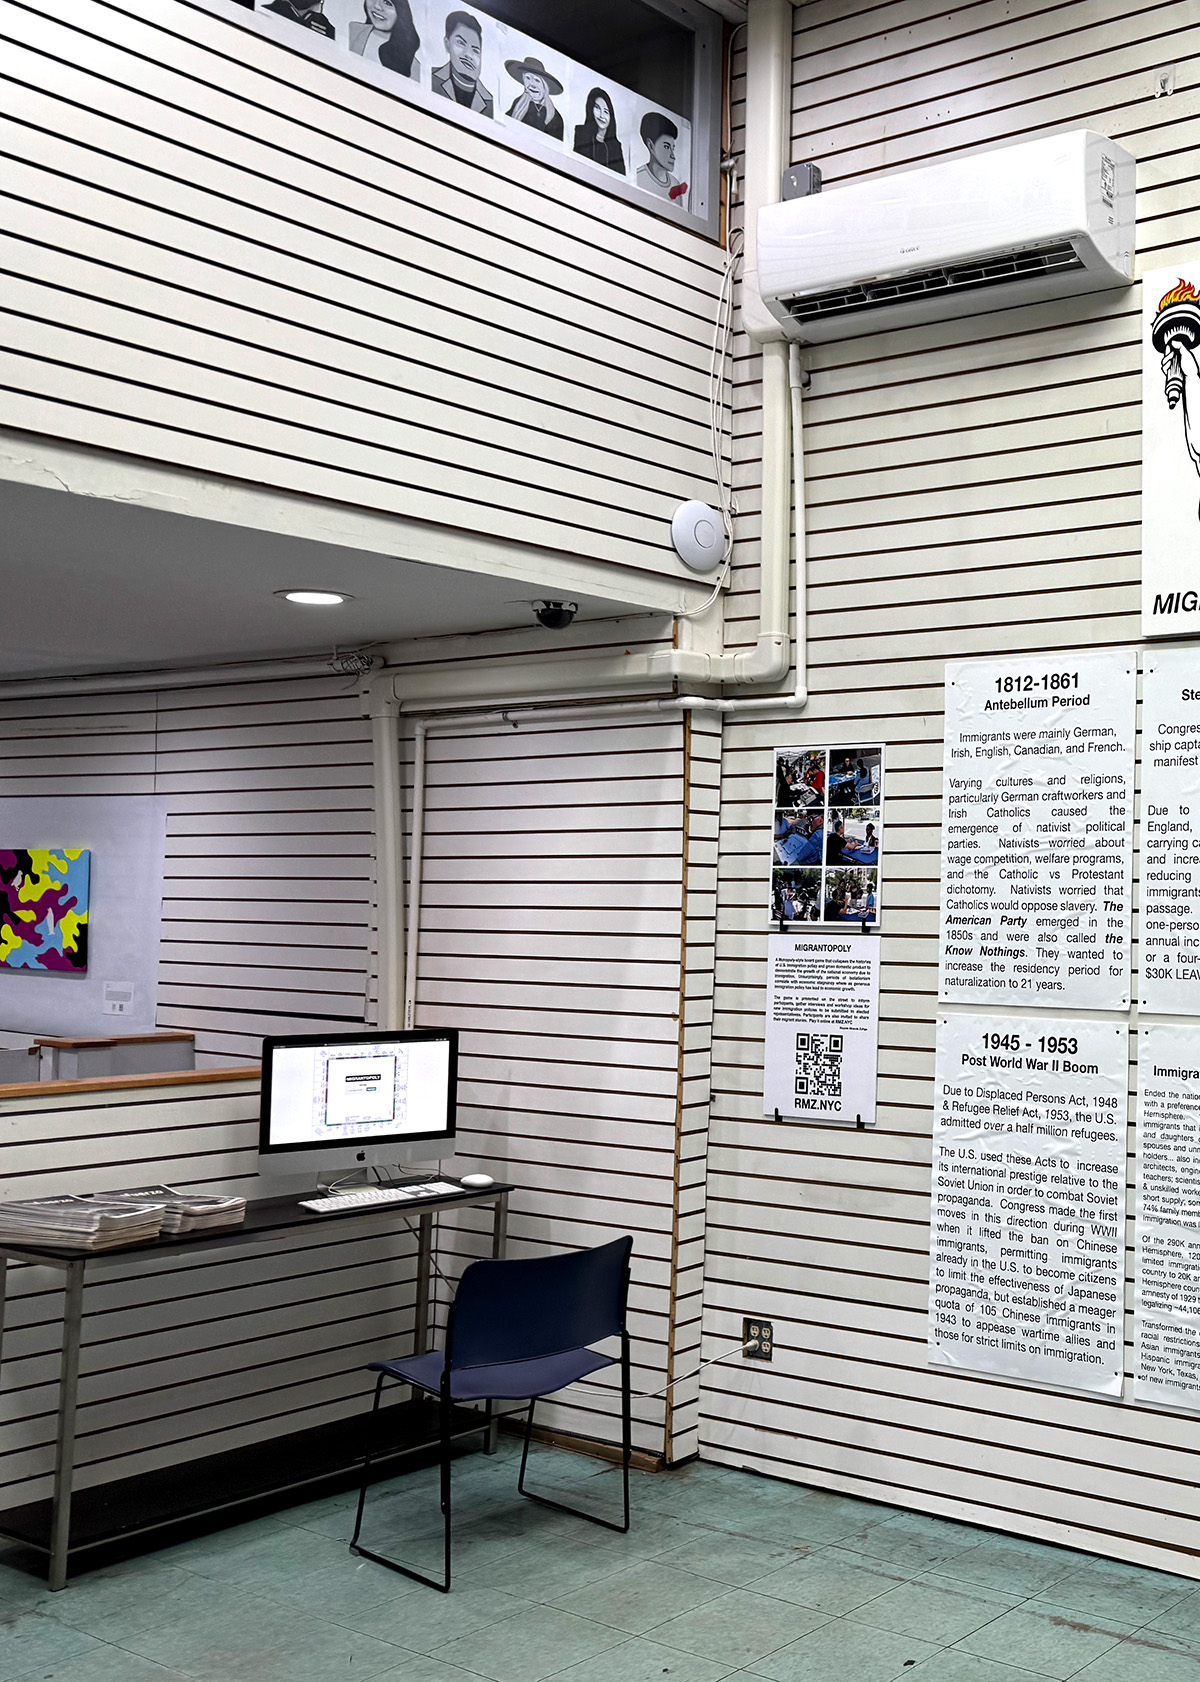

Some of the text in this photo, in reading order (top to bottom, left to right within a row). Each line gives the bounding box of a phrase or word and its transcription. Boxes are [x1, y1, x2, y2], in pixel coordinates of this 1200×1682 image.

[995, 672, 1078, 693] 1812-1861
[984, 694, 1090, 711] Antebellum Period
[951, 741, 1125, 759] Irish, English, Canadian, and French.
[794, 943, 852, 953] MIGRANTOPOLY
[1145, 967, 1173, 979] $30K
[982, 1033, 1020, 1051] 1945
[1038, 1036, 1078, 1055] 1953
[961, 1053, 1098, 1074] Post World War II Boom
[794, 1097, 842, 1112] RMZ.NYC
[1141, 1299, 1173, 1312] legalizing
[1149, 1376, 1162, 1384] new
